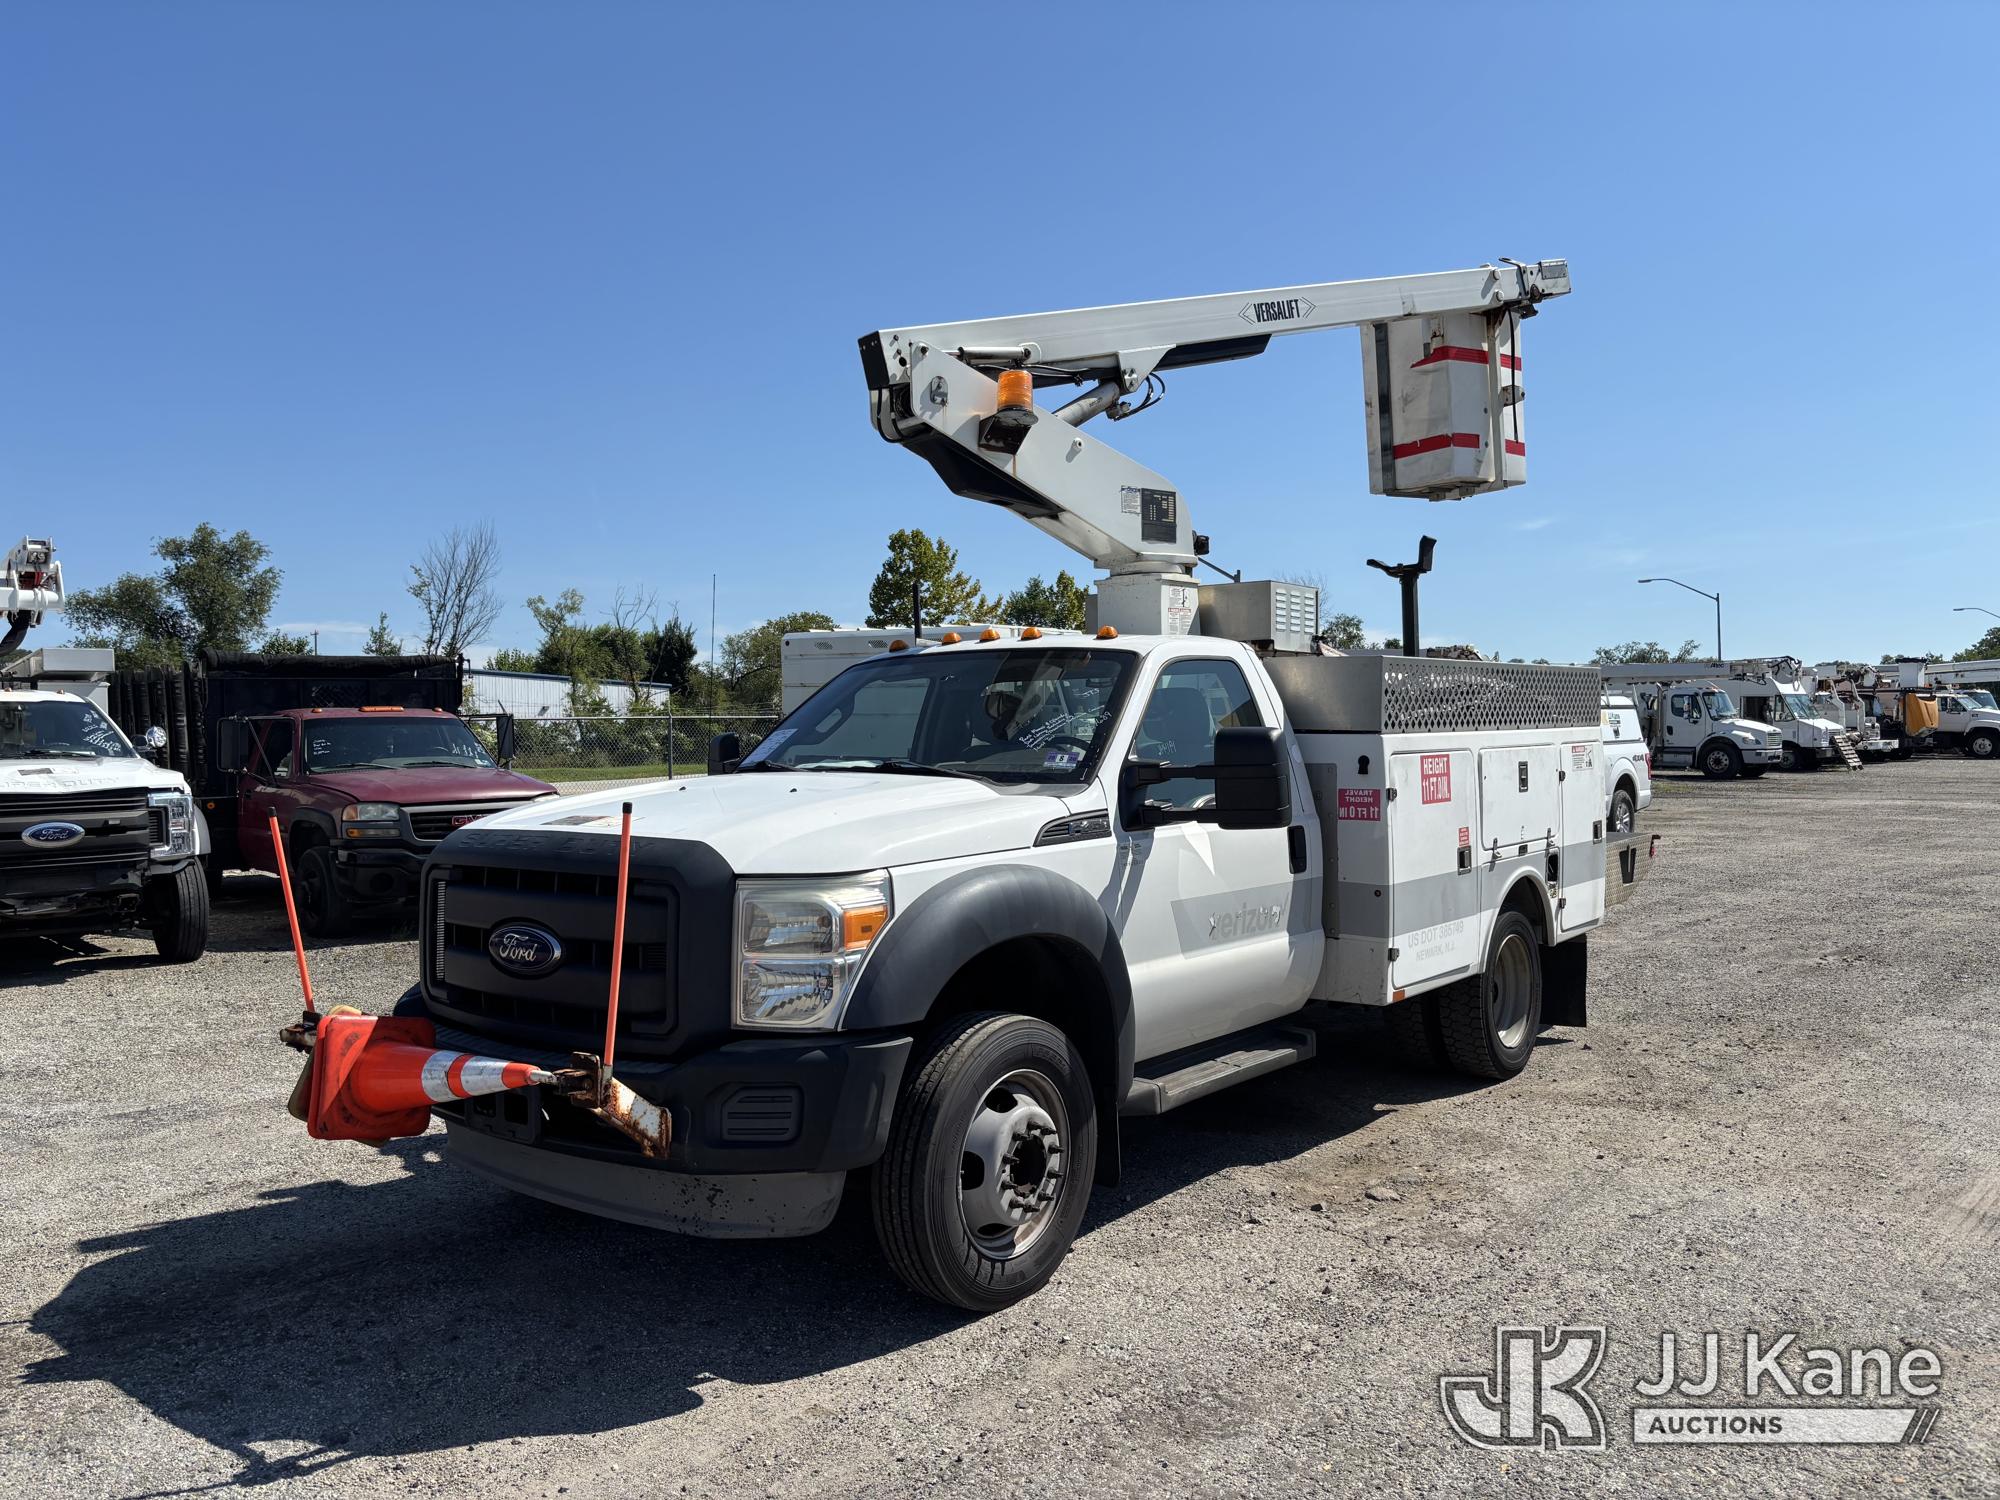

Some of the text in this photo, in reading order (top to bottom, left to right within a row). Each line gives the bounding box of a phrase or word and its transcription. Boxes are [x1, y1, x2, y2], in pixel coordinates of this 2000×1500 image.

[1253, 299, 1300, 323] VERSALIFT
[1423, 757, 1448, 775] HEIGHT
[452, 814, 484, 826] GM
[499, 932, 538, 963] Ford
[1408, 932, 1419, 949] US
[1421, 927, 1438, 944] DOT
